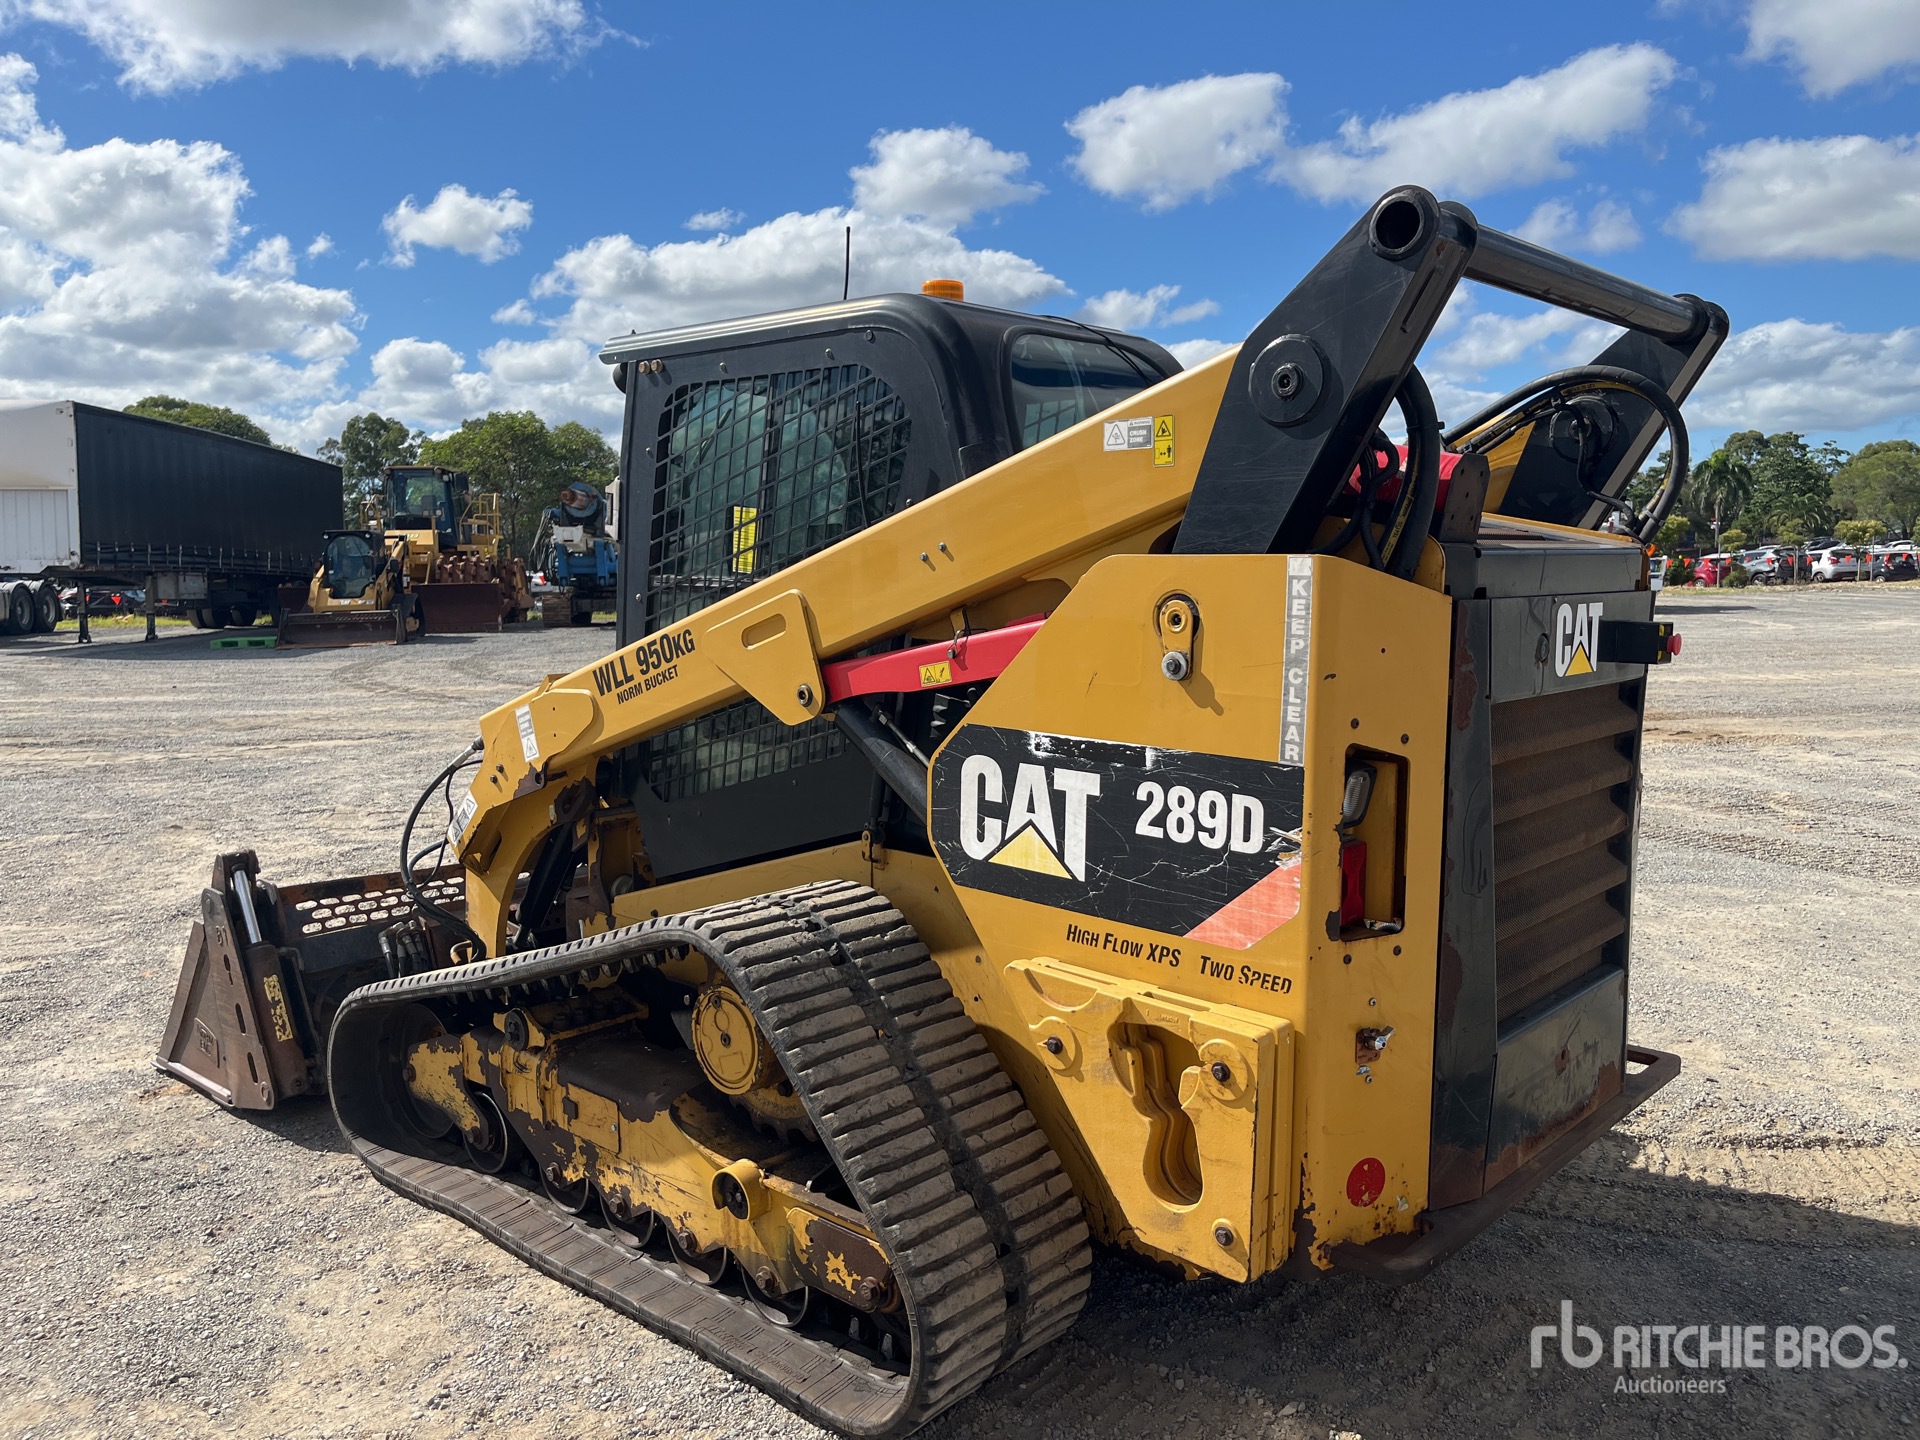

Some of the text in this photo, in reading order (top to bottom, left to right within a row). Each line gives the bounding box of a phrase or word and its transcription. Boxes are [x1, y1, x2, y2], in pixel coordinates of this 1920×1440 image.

[1290, 579, 1307, 654] KEEP
[1555, 602, 1603, 678] CAT
[592, 628, 695, 697] WLL 950KG
[616, 664, 679, 704] NORM BUCKET
[1284, 668, 1303, 761] CLEAR
[960, 754, 1265, 882] CAT 289D
[1066, 923, 1292, 995] HIGH FLOW XPS TWO SPEED
